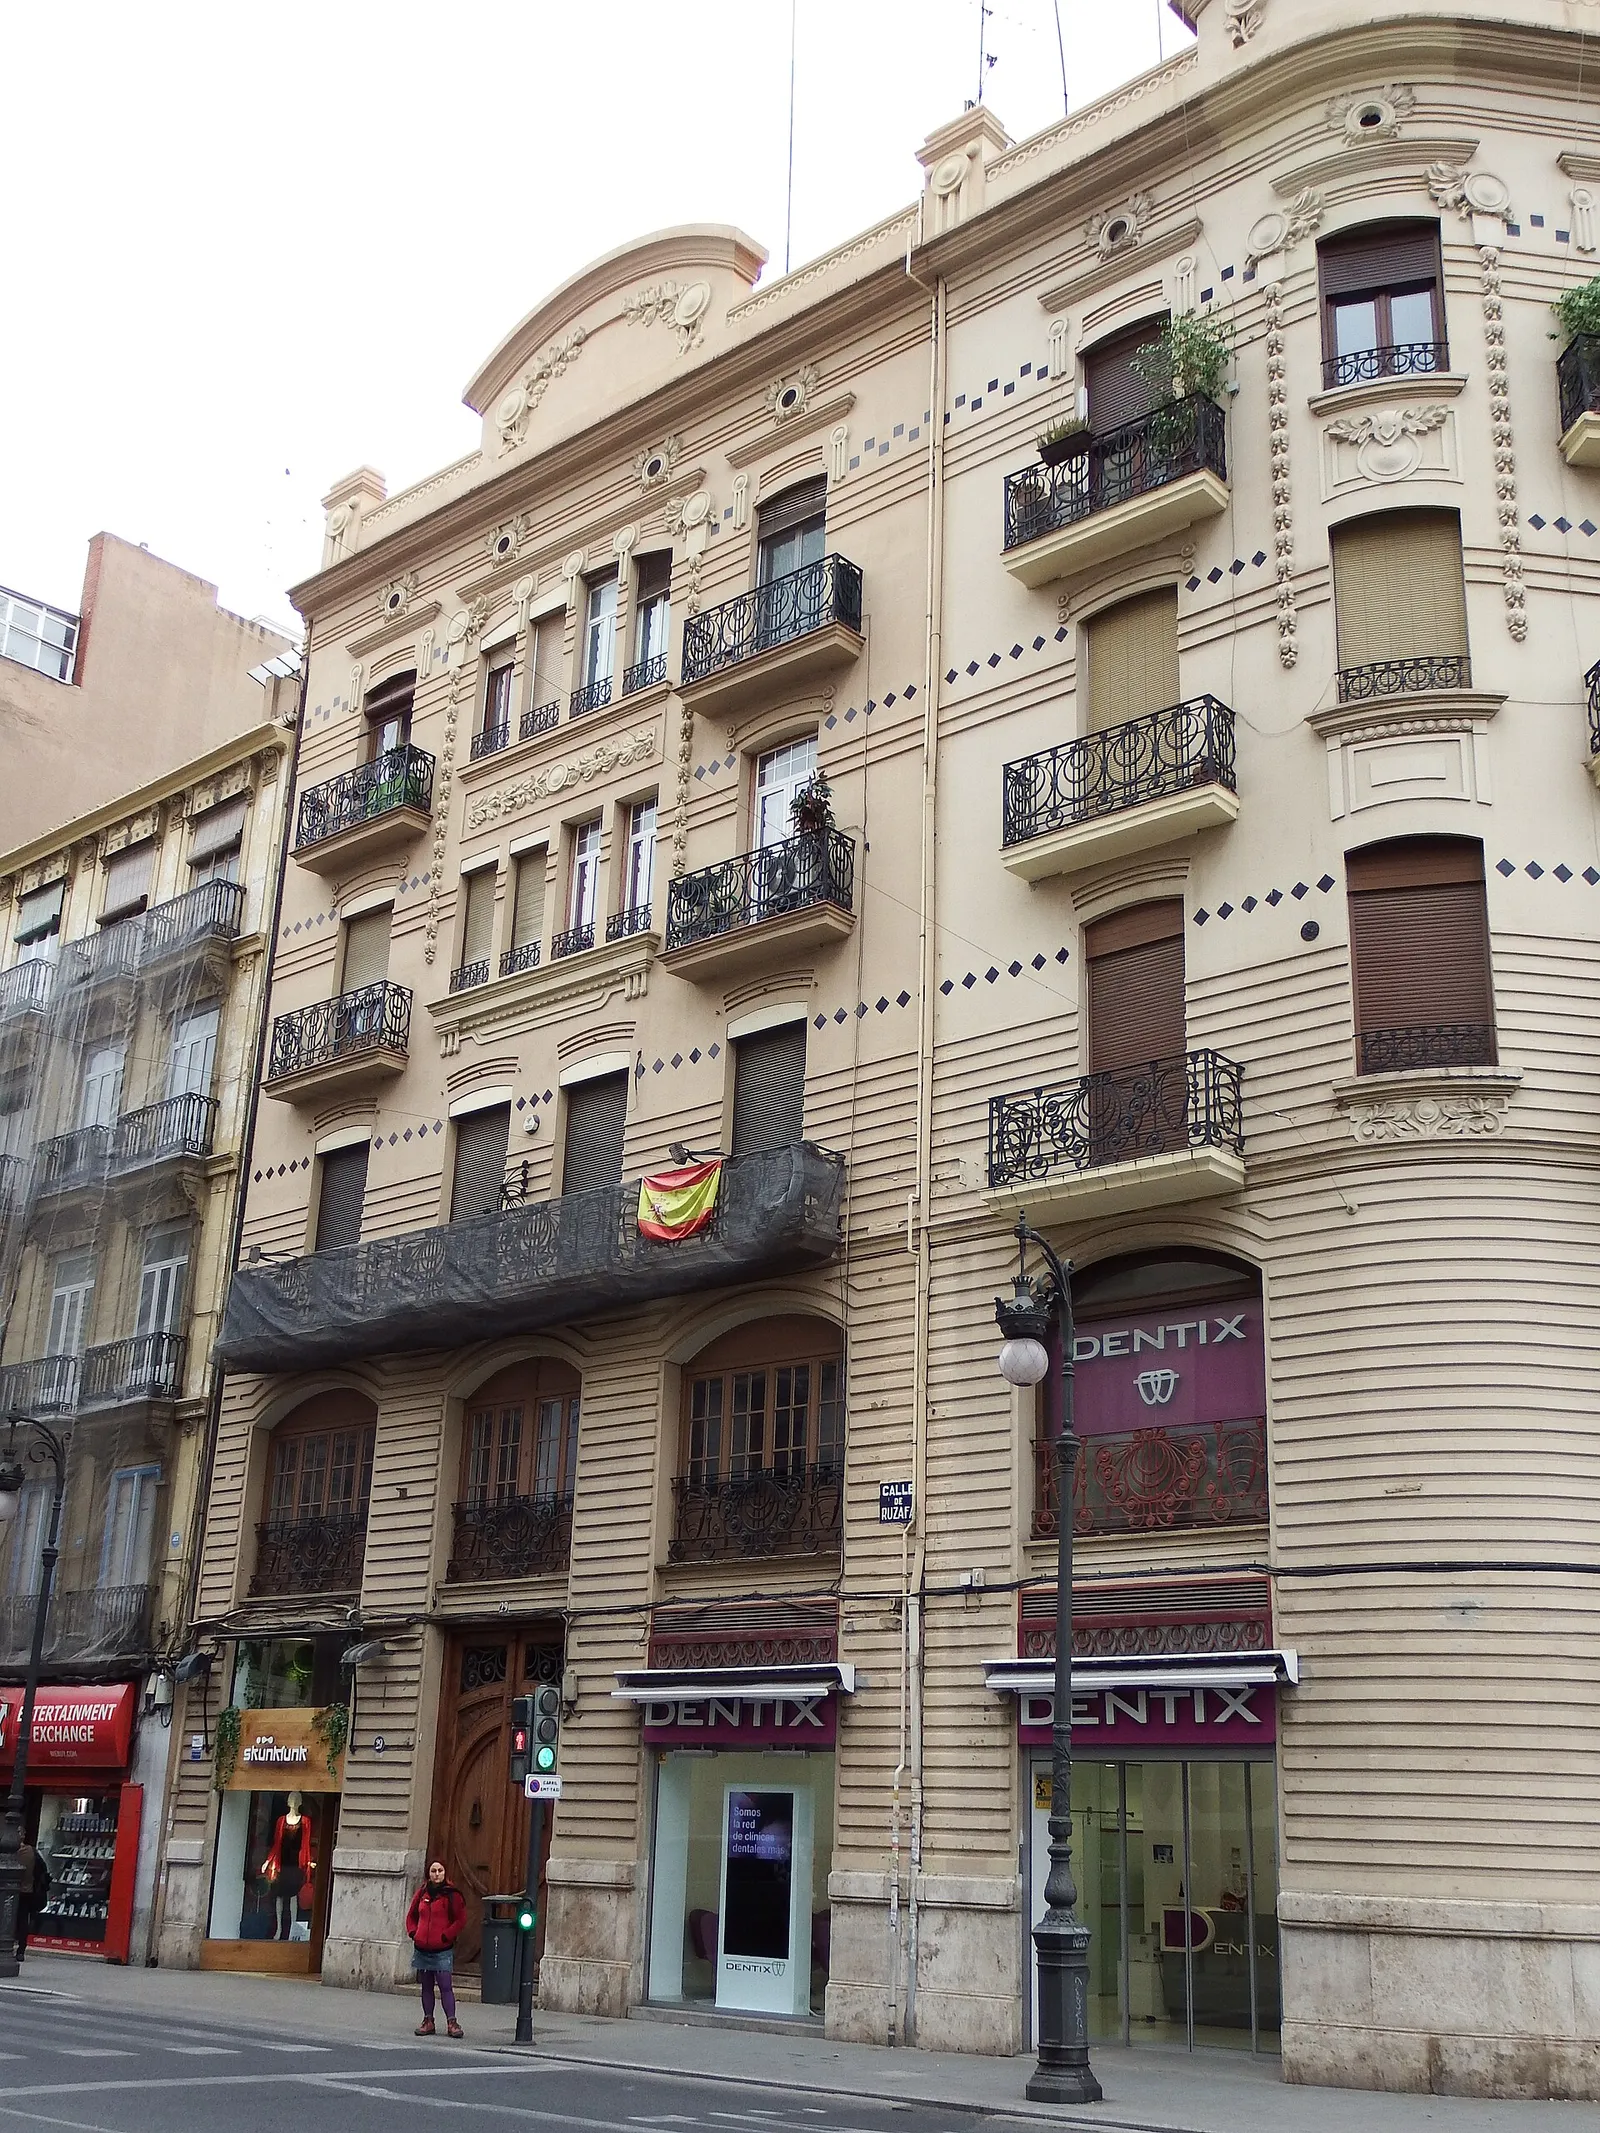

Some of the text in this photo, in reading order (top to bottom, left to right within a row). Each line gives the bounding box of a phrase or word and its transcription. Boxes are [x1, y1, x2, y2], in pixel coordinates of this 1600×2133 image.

[1073, 1314, 1246, 1361] DENTIX
[882, 1484, 912, 1496] CALLE
[894, 1497, 903, 1505] DE
[17, 1703, 118, 1722] ETERTAINMENT
[644, 1698, 825, 1727] DENTIX
[1020, 1689, 1262, 1725] DENTIX
[33, 1725, 95, 1742] EXCHANGE
[243, 1745, 308, 1762] skunkfunk
[734, 1807, 761, 1817] Somos
[733, 1820, 756, 1829] la red
[732, 1831, 743, 1841] de
[726, 1962, 771, 1973] DENTIX
